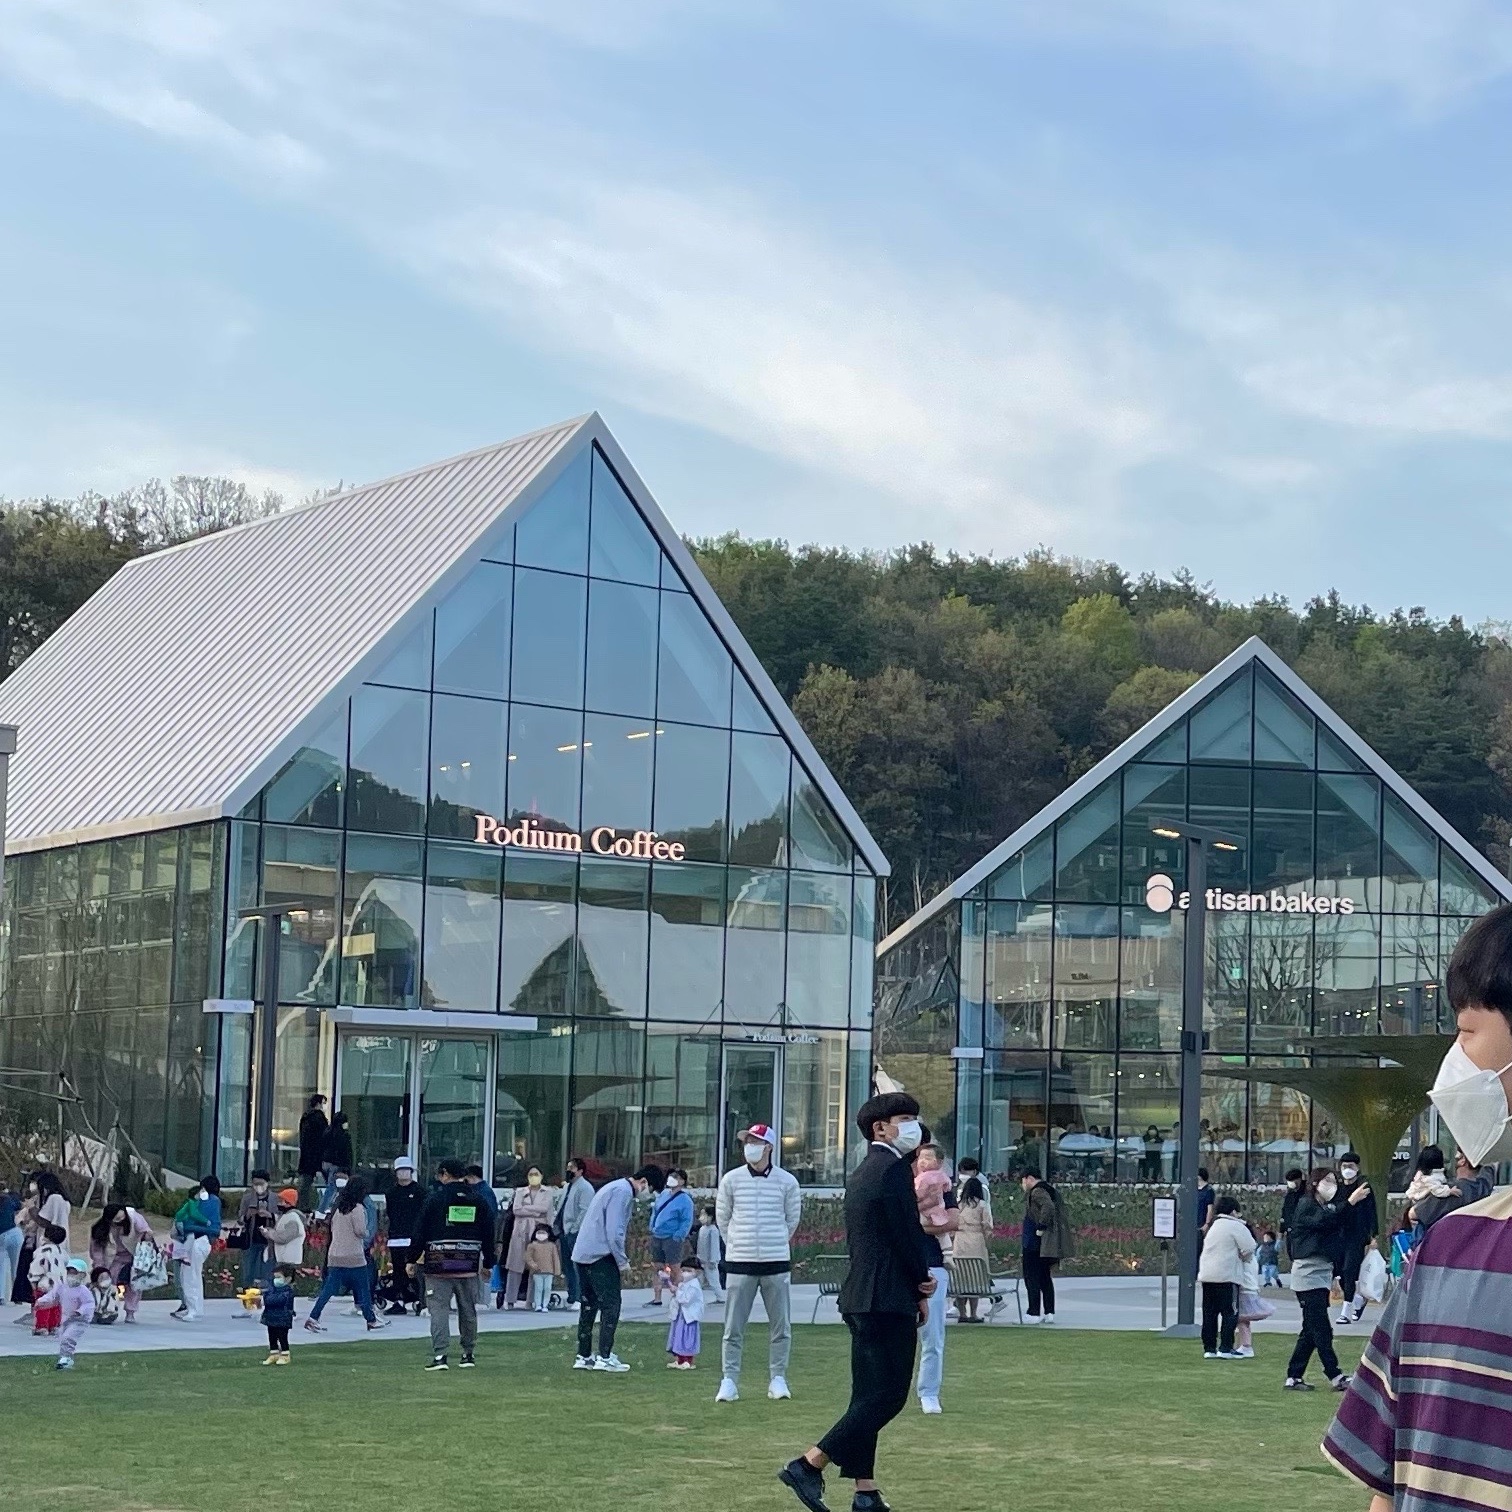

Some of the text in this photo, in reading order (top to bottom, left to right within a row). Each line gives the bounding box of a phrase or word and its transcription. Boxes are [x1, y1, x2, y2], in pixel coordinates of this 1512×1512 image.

[474, 814, 685, 861] Podium Coffee
[1178, 887, 1355, 914] atisan bakers
